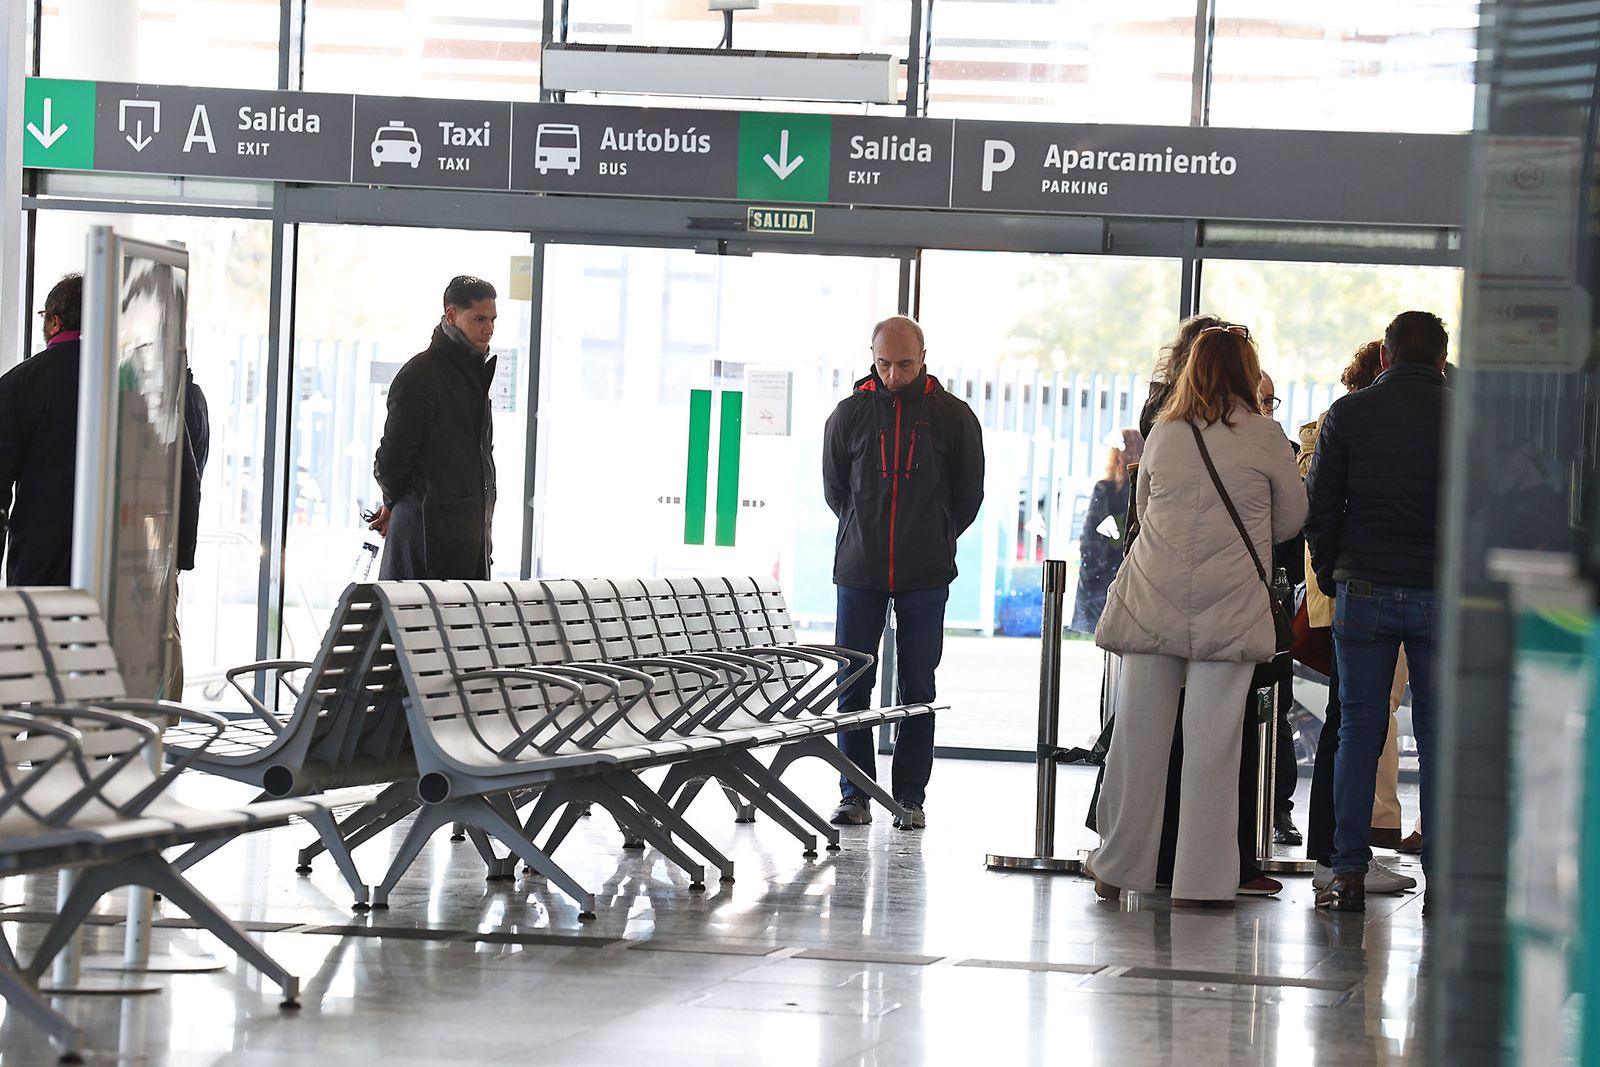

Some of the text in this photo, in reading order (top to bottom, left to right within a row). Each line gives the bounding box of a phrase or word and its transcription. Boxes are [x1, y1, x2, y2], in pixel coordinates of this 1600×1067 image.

[182, 104, 217, 154] A
[238, 105, 320, 133] Salida
[438, 120, 491, 147] Taxi
[600, 126, 711, 154] Autobús
[237, 141, 270, 156] EXIT
[849, 135, 932, 163] Salida
[1043, 143, 1237, 176] Aparcamiento
[438, 157, 470, 171] TAXI
[599, 162, 627, 176] BUS
[848, 170, 881, 185] EXIT
[981, 139, 1016, 192] P
[1041, 179, 1108, 195] PARKING
[753, 212, 808, 229] SALIDA
